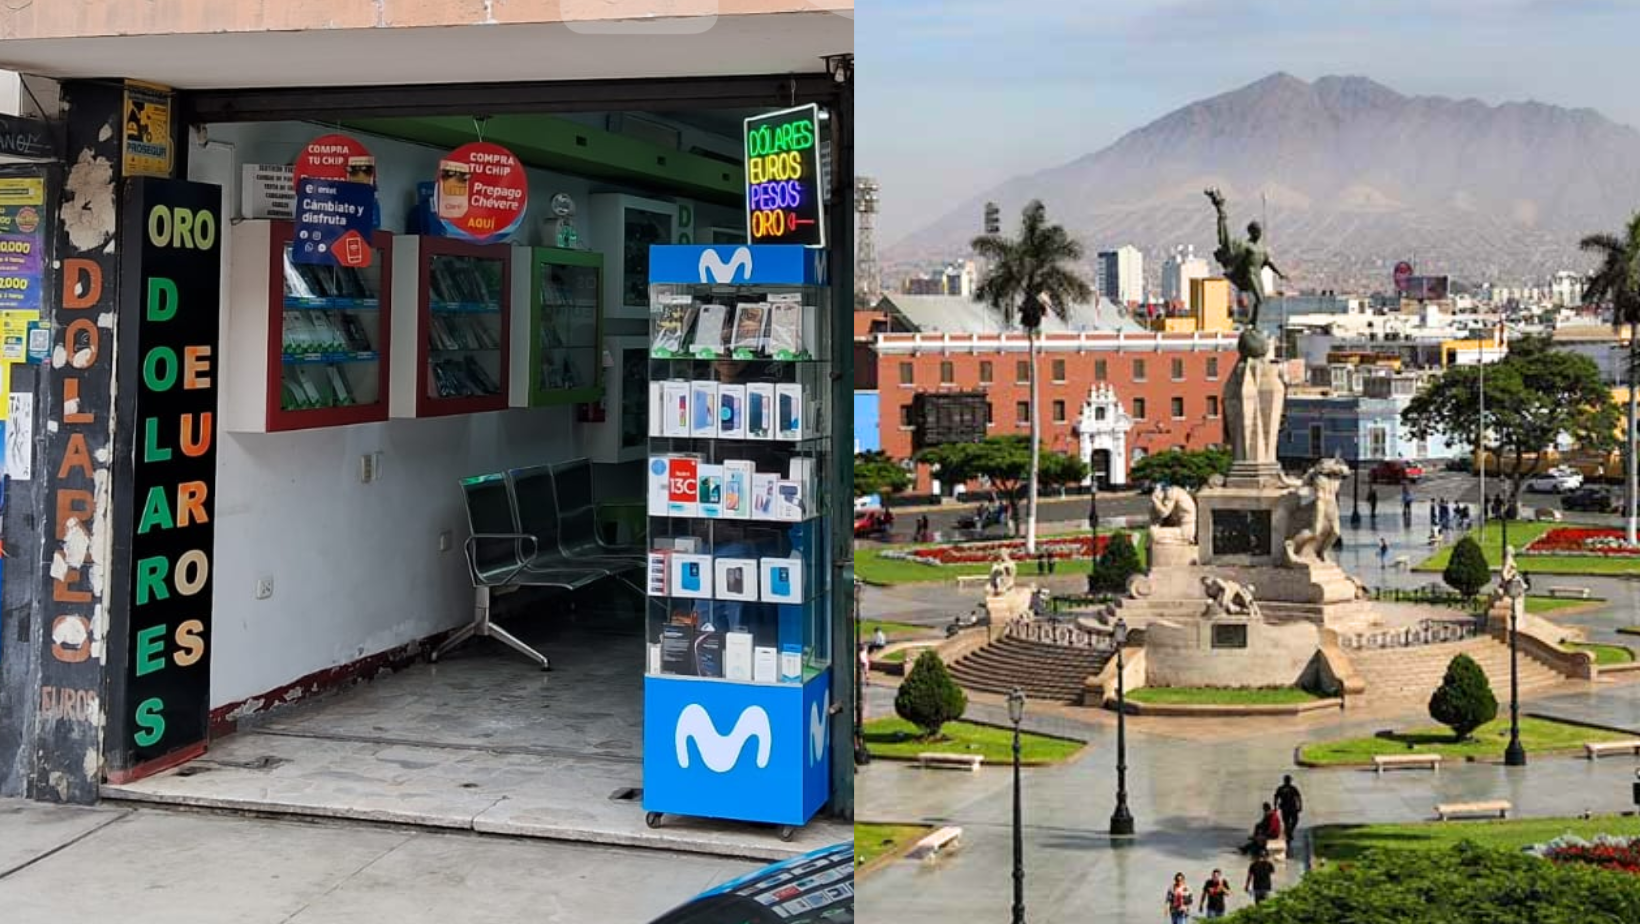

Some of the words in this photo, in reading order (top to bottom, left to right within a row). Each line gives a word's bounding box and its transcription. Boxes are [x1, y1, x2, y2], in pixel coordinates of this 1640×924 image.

[750, 120, 813, 156] DÓLARES
[127, 142, 166, 159] PROSEGUR
[308, 145, 349, 154] COMPRA
[308, 156, 319, 165] TU
[322, 156, 344, 165] CHIP
[469, 152, 515, 166] COMPRA
[751, 151, 801, 184] EUROS
[469, 163, 483, 173] TU
[485, 165, 511, 176] CHIP
[473, 182, 522, 199] Prepago
[752, 180, 800, 210] PESOS
[357, 205, 364, 217] y
[471, 195, 519, 210] Chévere
[148, 204, 215, 250] ORO
[302, 212, 347, 226] disfruta
[467, 216, 495, 230] AQUÍ
[752, 209, 785, 238] ORO
[669, 478, 697, 495] 13C
[134, 277, 179, 747] DOLARES
[173, 345, 213, 667] EUROS
